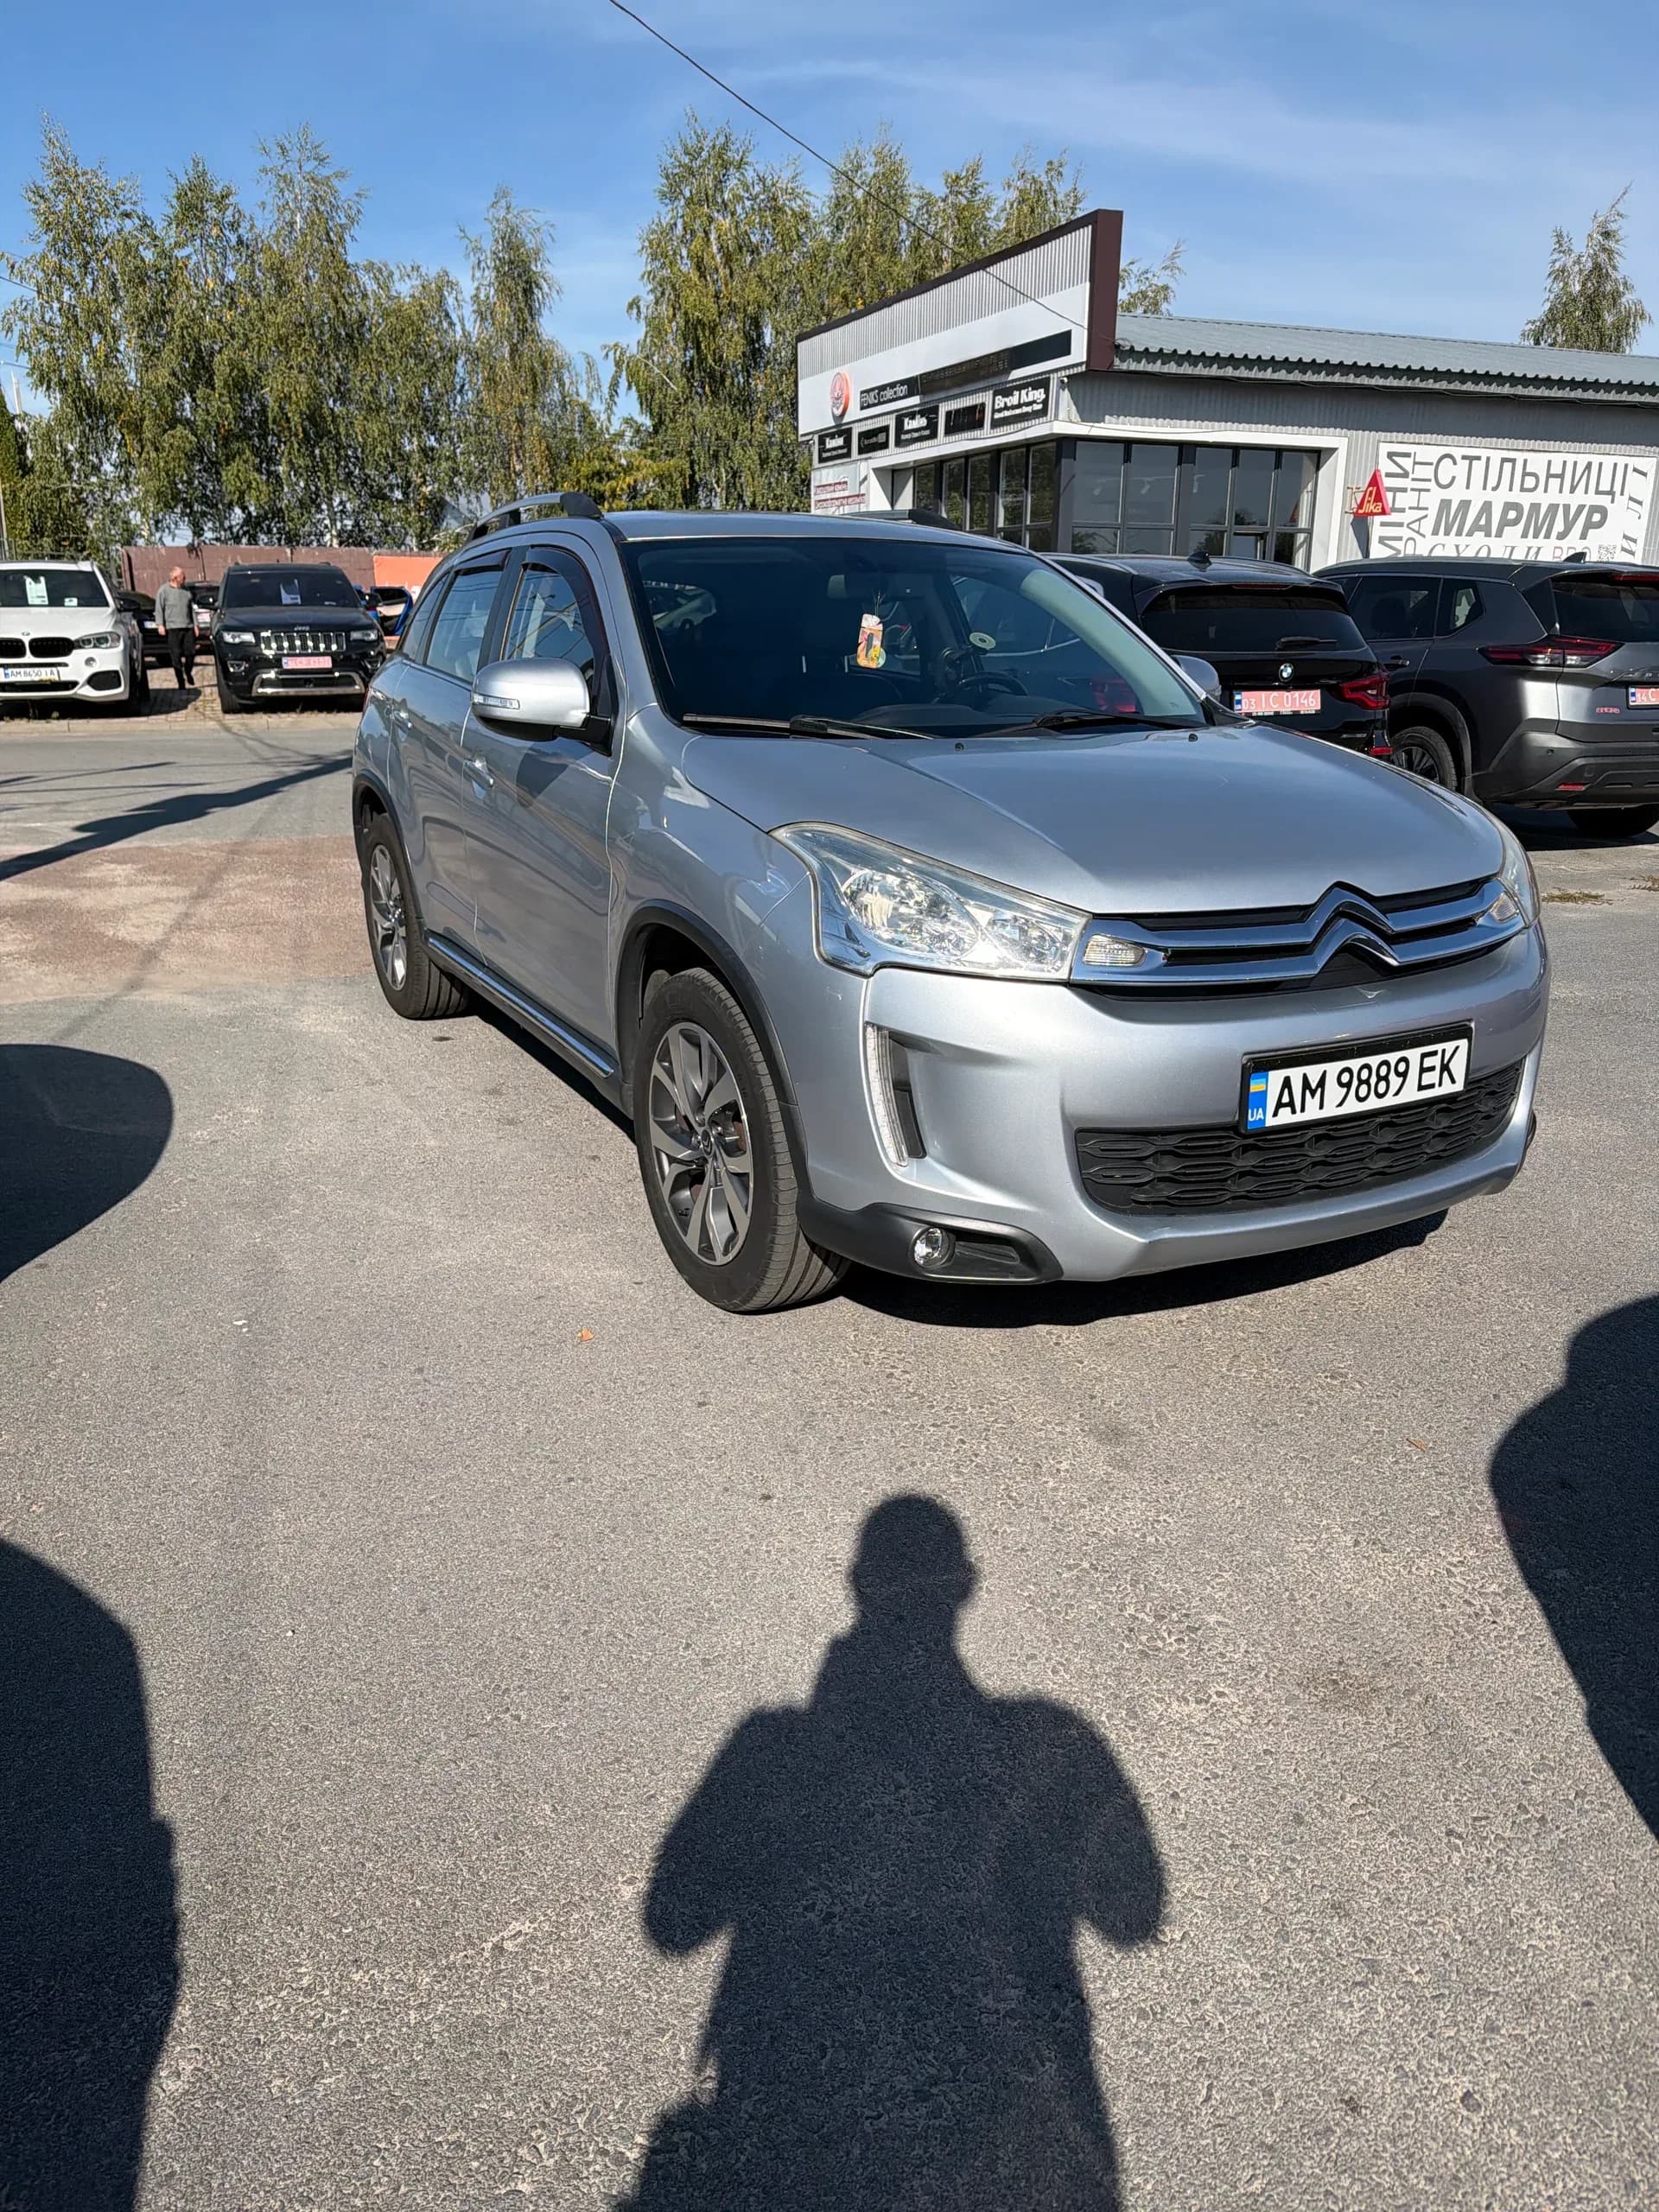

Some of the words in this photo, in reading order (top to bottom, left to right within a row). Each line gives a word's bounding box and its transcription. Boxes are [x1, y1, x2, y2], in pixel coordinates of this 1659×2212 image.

[995, 390, 1020, 410] Broil
[1433, 453, 1629, 504] СТІЛЬНИЦІ
[1358, 486, 1382, 513] Sika
[1431, 499, 1608, 541] МАРМУР
[1243, 699, 1255, 709] 03
[1283, 692, 1316, 708] 0146
[1272, 1070, 1327, 1118] AM
[1336, 1056, 1410, 1109] 9889
[1417, 1045, 1460, 1093] EK
[1249, 1107, 1264, 1122] UA
